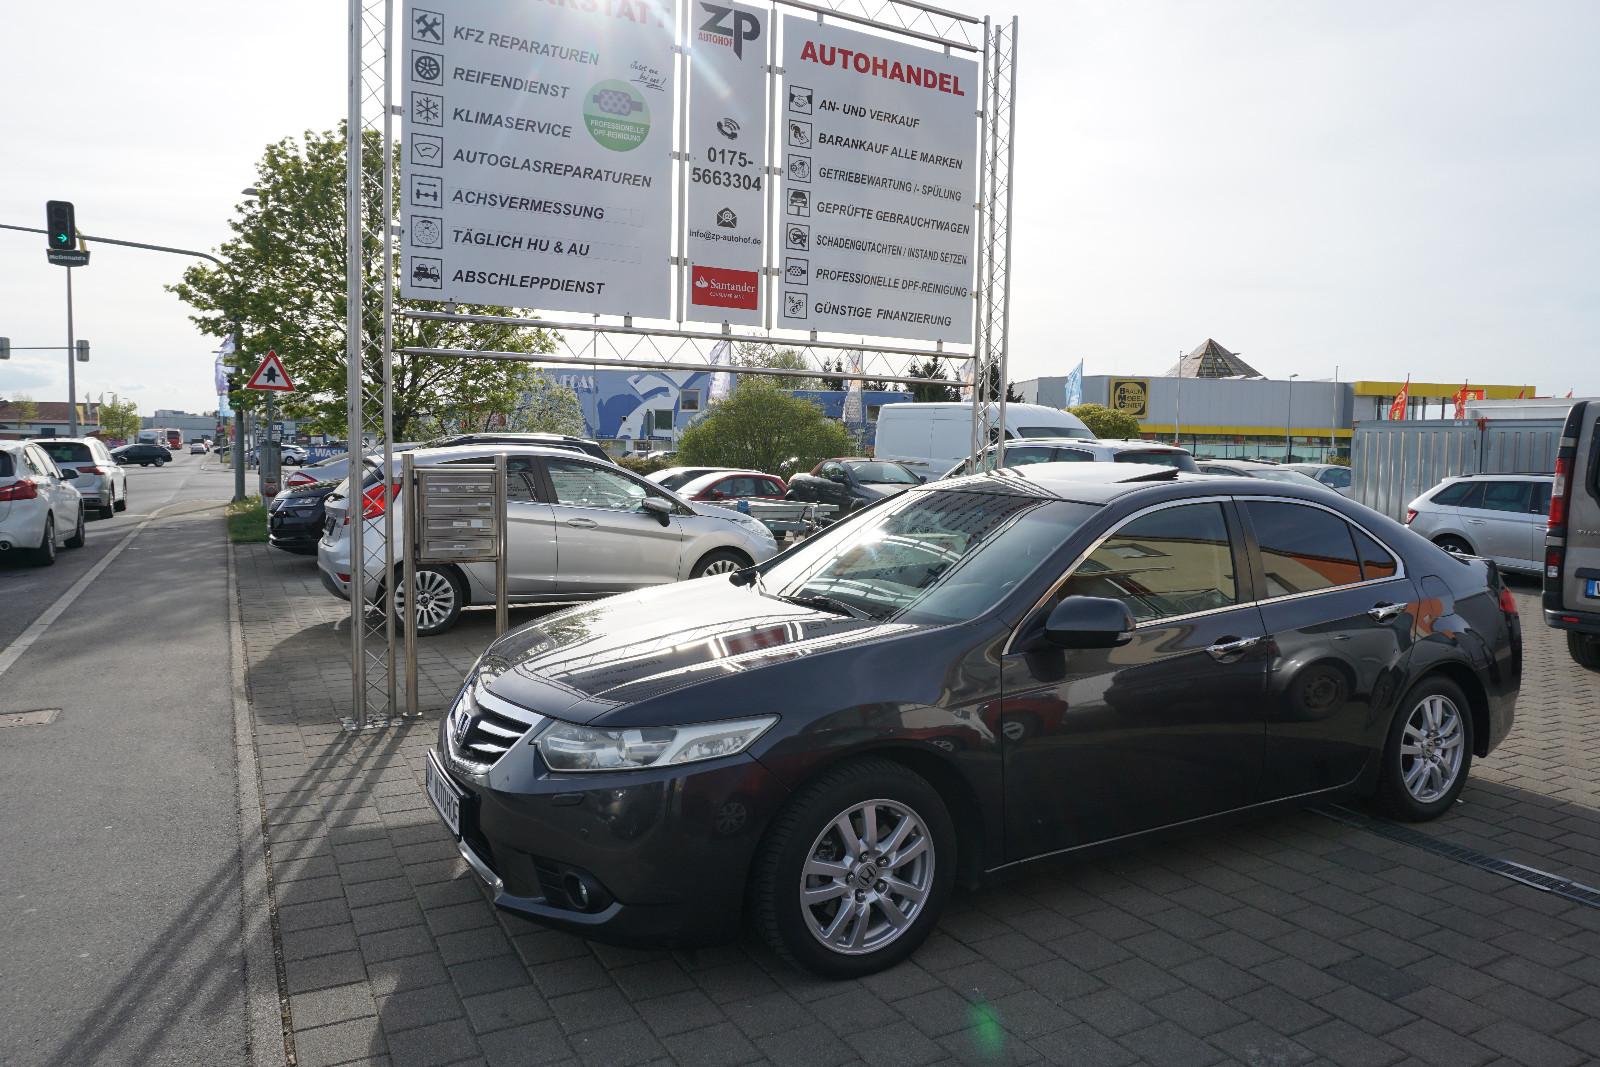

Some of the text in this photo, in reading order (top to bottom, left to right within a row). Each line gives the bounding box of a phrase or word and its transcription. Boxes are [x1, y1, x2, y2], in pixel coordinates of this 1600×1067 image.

[453, 25, 599, 66] KFZ REPARATUREN
[453, 66, 570, 99] REIFENDIENST
[800, 40, 965, 96] AUTOHANDEL
[452, 107, 573, 139] KLIMASERVICE
[819, 99, 921, 129] AN- UND VERKAUF
[707, 146, 754, 168] 0175-
[818, 132, 963, 170] BARANKAUF ALLE MARKEN
[452, 148, 652, 188] AUTOGLASREPARATUREN
[691, 166, 762, 192] 5663304
[819, 167, 912, 193] GETRIEBEWARTUNG
[921, 184, 962, 202] SPÜLUNG
[452, 189, 605, 220] ACHSVERMESSUNG
[816, 201, 970, 235] GEPRÜFTE GEBRAUCHTWAGEN
[453, 228, 590, 256] TÄGLICH HU & AU
[816, 234, 902, 256] SCHADENGUTACHTEN
[907, 248, 939, 262] INSTAND
[939, 252, 968, 265] SETZEN
[452, 269, 606, 295] ABSCHLEPPDIENST
[710, 278, 756, 293] Santander
[815, 268, 968, 298] PROFESSIONELLE DPF-REINIGUNG
[814, 301, 952, 327] GÜNSTIGE FINANZIERUNG
